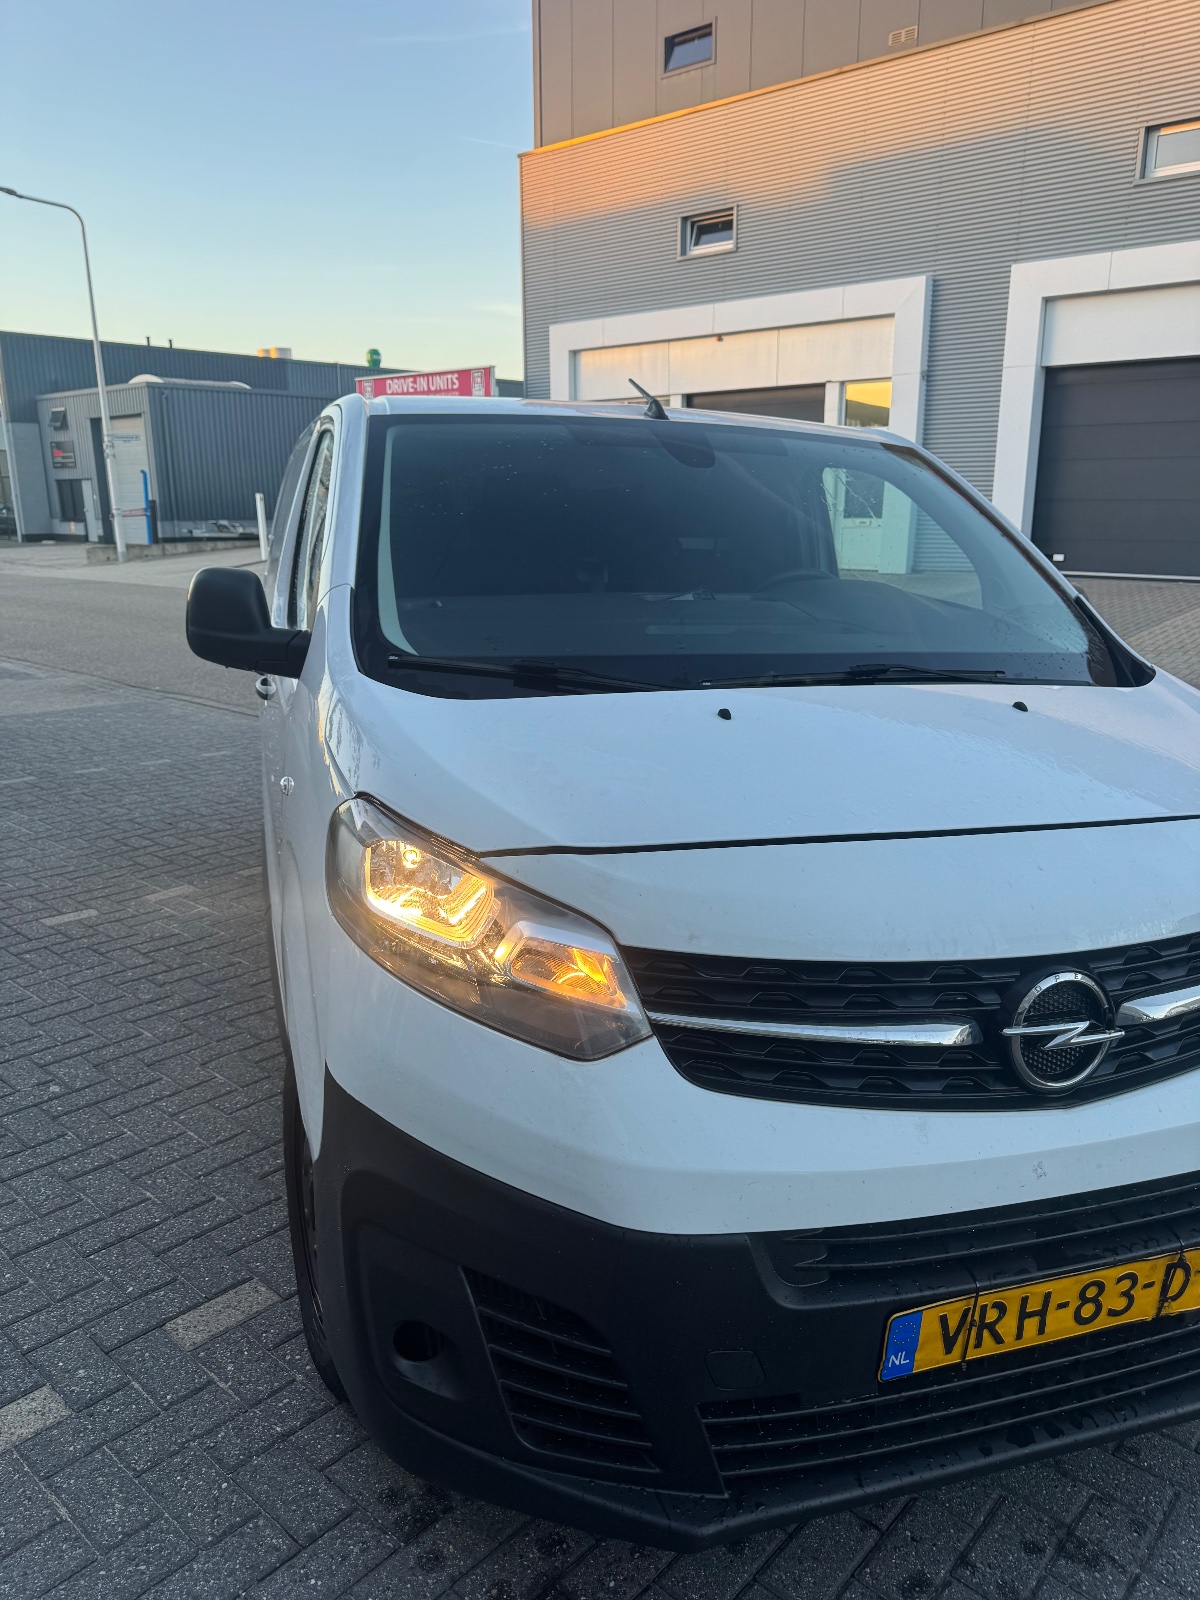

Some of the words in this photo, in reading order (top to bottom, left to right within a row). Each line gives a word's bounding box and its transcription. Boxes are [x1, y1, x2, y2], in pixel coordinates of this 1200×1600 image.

[386, 377, 427, 394] DRIVE-IN
[429, 374, 460, 390] UNITS
[1035, 972, 1095, 993] OPE
[888, 1351, 910, 1367] NL
